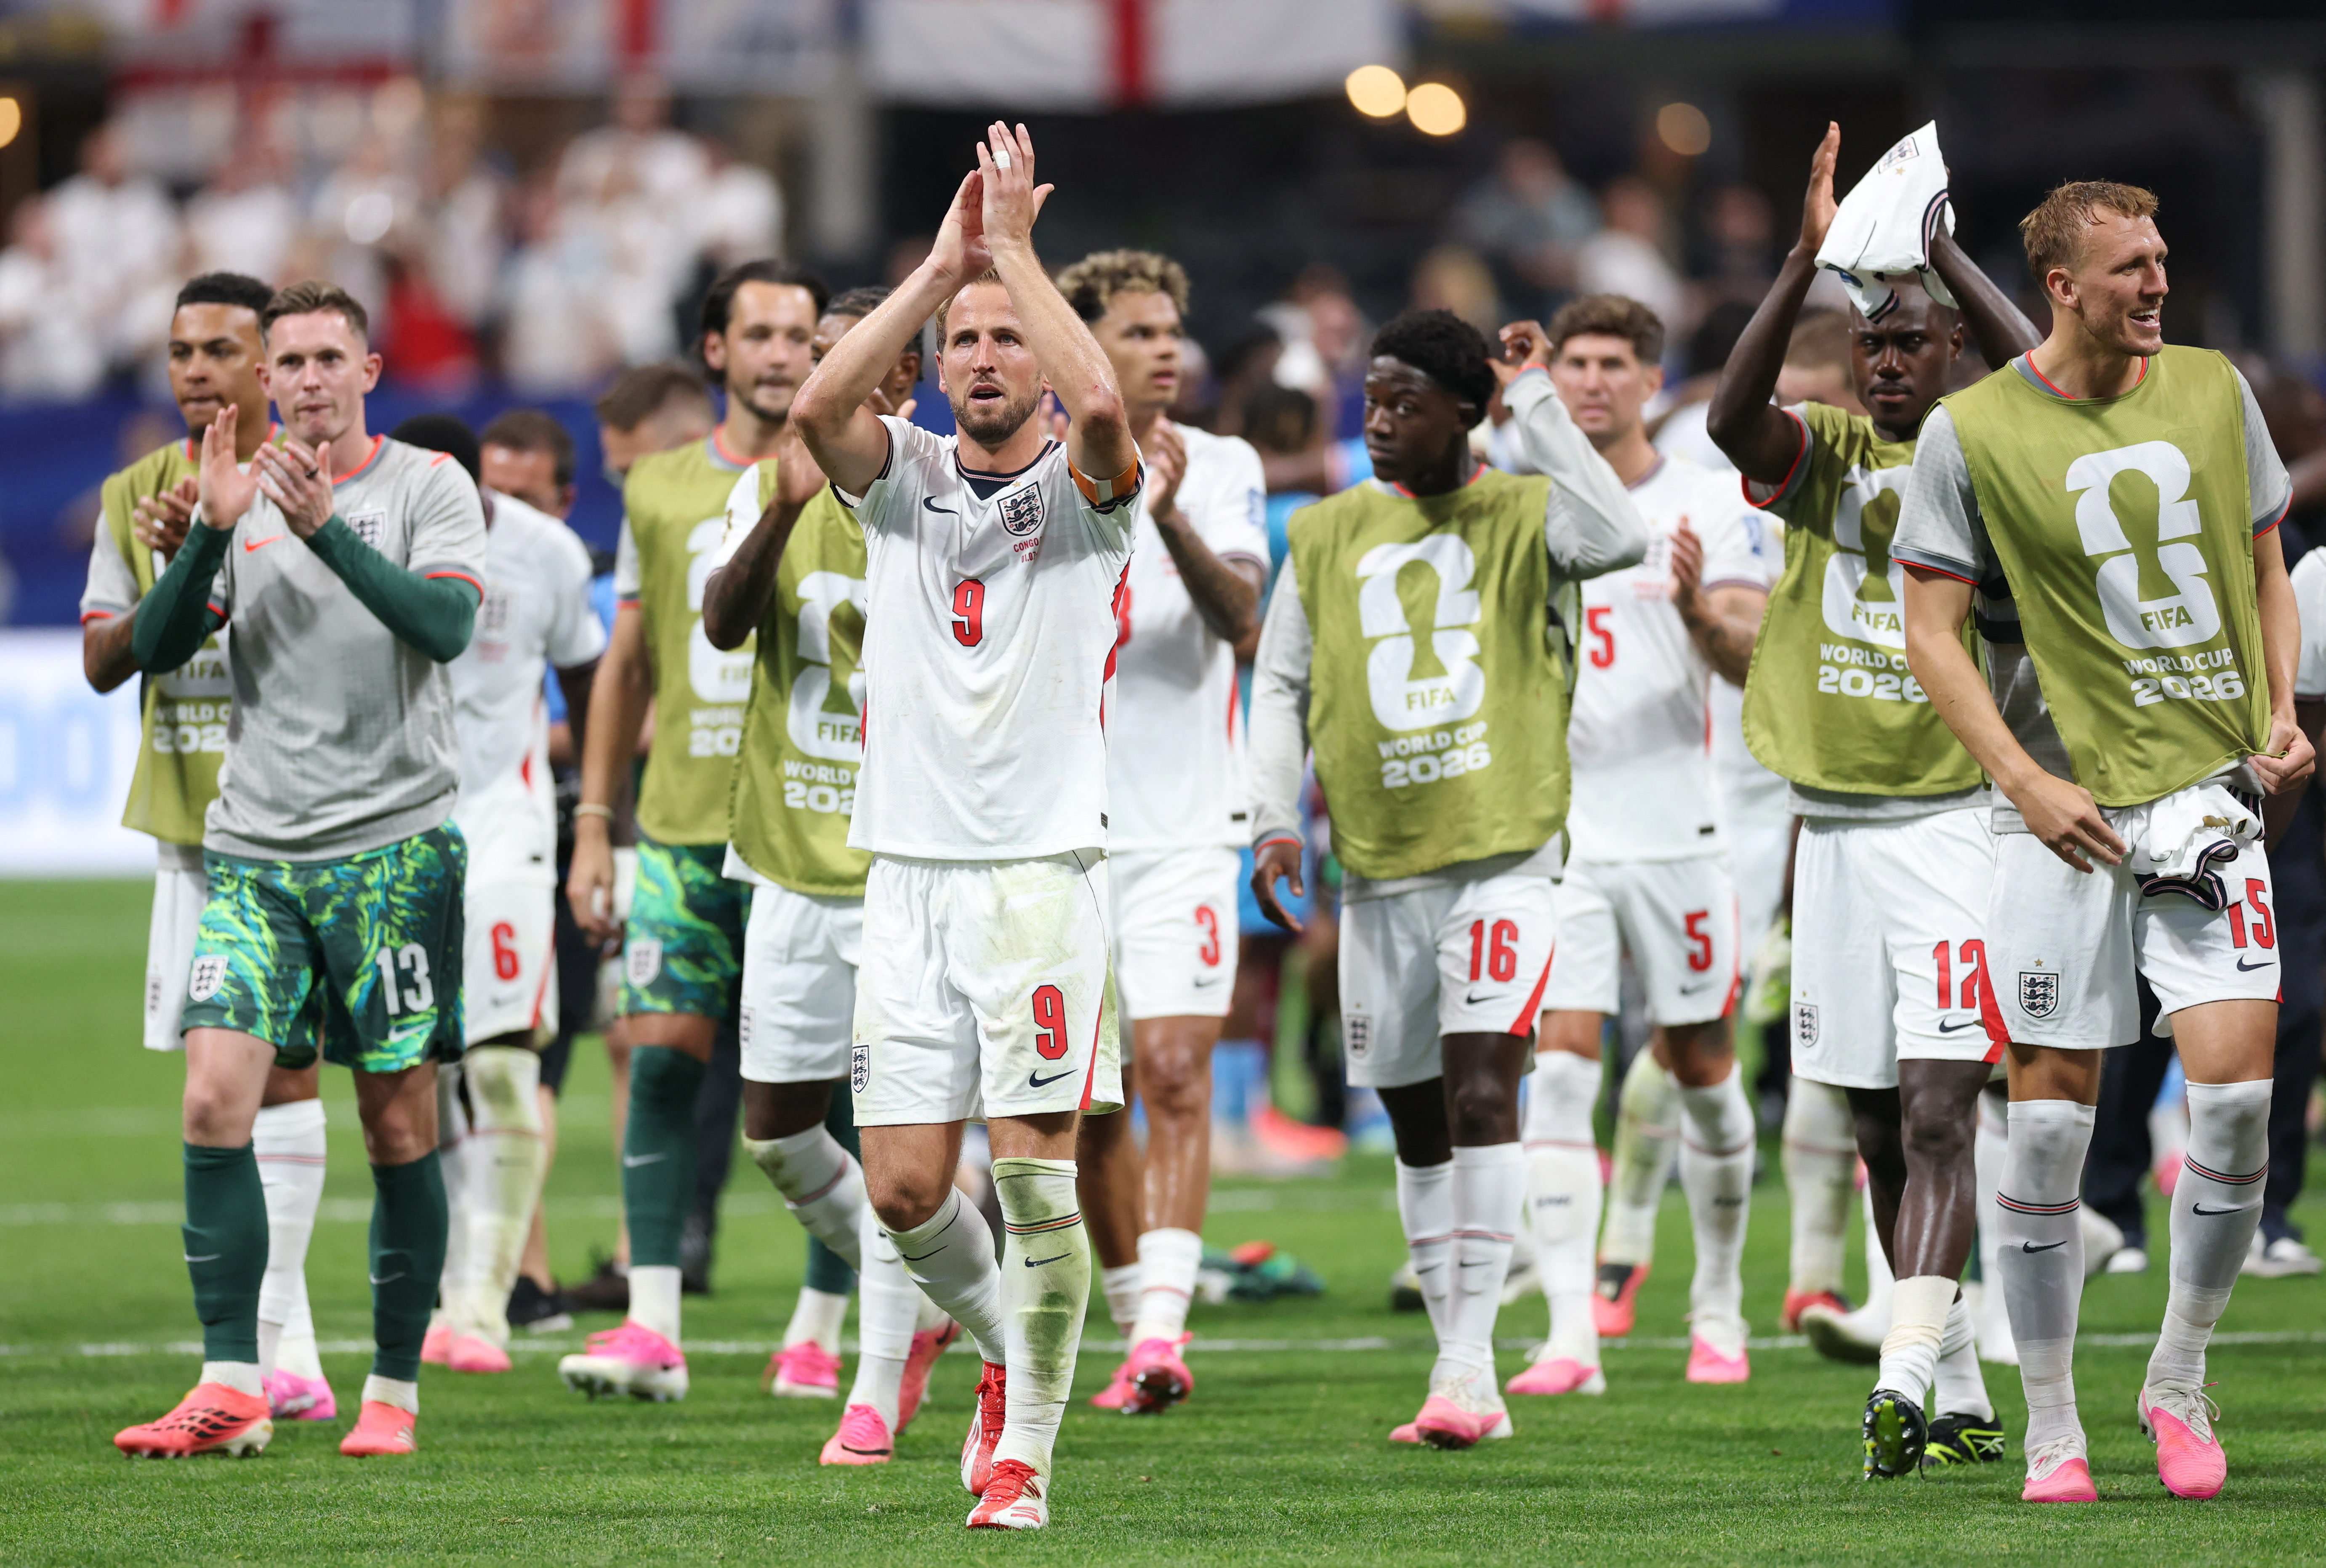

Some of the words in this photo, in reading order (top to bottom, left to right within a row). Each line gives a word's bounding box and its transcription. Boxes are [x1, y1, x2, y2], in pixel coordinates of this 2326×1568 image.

[1014, 538, 1039, 552] CONGO
[952, 579, 985, 647] 9
[1853, 603, 1901, 632] FIFA
[2140, 606, 2194, 631] FIFA
[1586, 606, 1614, 669] 5
[1820, 643, 1887, 668] WORLD
[2123, 655, 2195, 675] WORLD
[2194, 648, 2233, 670] CUP
[1406, 688, 1456, 710] FIFA
[1818, 665, 1929, 703] 2026
[2131, 671, 2244, 707] 2026
[153, 724, 227, 754] 202
[1378, 731, 1452, 758] WORLD
[1454, 720, 1488, 745] CUP
[784, 759, 852, 785] WORLD
[1381, 741, 1492, 789] 2026
[784, 781, 855, 815] 202
[2227, 878, 2275, 949] 15
[490, 922, 519, 981] 6
[1194, 905, 1220, 967] 3
[1469, 919, 1518, 982] 16
[1684, 909, 1712, 972] 5
[376, 942, 434, 1015] 13
[1933, 938, 1984, 1009] 12
[1032, 984, 1068, 1060] 9
